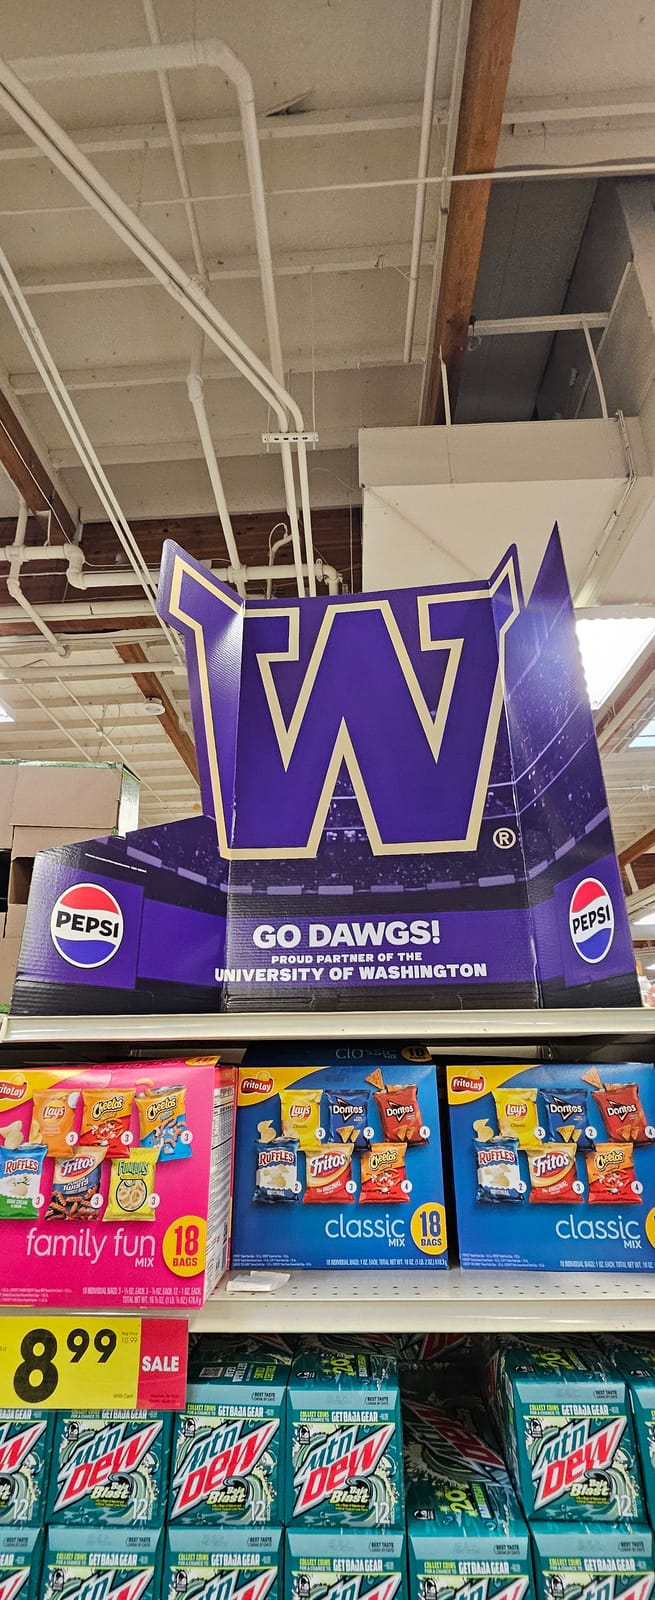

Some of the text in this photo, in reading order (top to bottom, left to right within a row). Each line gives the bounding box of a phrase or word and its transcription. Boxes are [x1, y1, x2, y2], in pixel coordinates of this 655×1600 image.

[169, 554, 520, 860] W
[56, 910, 119, 938] PEPSI
[572, 904, 611, 935] PEPSI
[252, 919, 441, 949] GO DAWGS!
[271, 951, 423, 965] PROUD PARTNER OF THE
[215, 963, 488, 982] UNIVERSITY OF WASHINGTON
[92, 1096, 124, 1121] Cheetos
[146, 1096, 178, 1122] Cheetos
[333, 1104, 364, 1115] Doritos
[386, 1105, 415, 1117] Doritos
[550, 1103, 583, 1114] Doritos
[607, 1104, 637, 1117] Doritos
[366, 1127, 373, 1137] 2
[421, 1127, 427, 1137] 4
[538, 1127, 543, 1137] 3
[588, 1127, 594, 1137] 2
[647, 1126, 654, 1137] 4
[259, 1149, 295, 1166] RUFFLES
[369, 1149, 399, 1171] Cheetos
[478, 1148, 516, 1165] RUFFLES
[595, 1150, 625, 1171] Cheetos
[5, 1159, 39, 1174] RUFFLES
[61, 1156, 95, 1177] Fritos
[310, 1154, 347, 1178] Fritos
[533, 1153, 570, 1177] Fritos
[294, 1183, 300, 1192] 2
[348, 1182, 354, 1192] 3
[403, 1182, 409, 1192] 4
[518, 1182, 524, 1191] 2
[575, 1182, 581, 1192] 3
[634, 1182, 641, 1191] 4
[35, 1196, 41, 1206] 3
[94, 1196, 100, 1206] 3
[151, 1196, 157, 1206] 3
[324, 1213, 406, 1239] classic
[420, 1210, 442, 1238] 18
[555, 1213, 641, 1240] classic
[26, 1227, 156, 1264] family fun
[174, 1224, 200, 1257] 18
[388, 1238, 406, 1248] MIX
[420, 1238, 443, 1247] BAGS
[623, 1240, 642, 1249] MIX
[135, 1258, 155, 1268] MIX
[173, 1258, 198, 1267] BAGS
[13, 1328, 117, 1404] 8 99
[142, 1355, 180, 1373] SALE
[15, 1410, 32, 1420] GEAR
[102, 1410, 113, 1420] GET
[113, 1410, 130, 1420] BAJA
[131, 1410, 147, 1420] GEAR
[218, 1405, 230, 1418] GET
[230, 1405, 246, 1418] BAJA
[246, 1405, 264, 1418] GEAR
[332, 1411, 379, 1423] GET BAJA GEAR
[561, 1404, 610, 1417] GET BAJA GEAR
[91, 1486, 130, 1500] Blast
[329, 1490, 370, 1504] Blast
[569, 1483, 610, 1498] Blast
[207, 1490, 246, 1505] Blast
[444, 1489, 475, 1515] 20
[133, 1500, 148, 1521] 12
[250, 1501, 265, 1522] 12
[616, 1495, 633, 1517] 12
[375, 1502, 390, 1524] 12
[88, 1553, 138, 1566] GET BAJA GEAR
[211, 1553, 260, 1566] GET BAJA GEAR
[333, 1559, 383, 1572] GET BAJA GEAR
[584, 1558, 636, 1571] GET BAJA GEAR
[458, 1562, 510, 1575] GET BAJA GEAR
